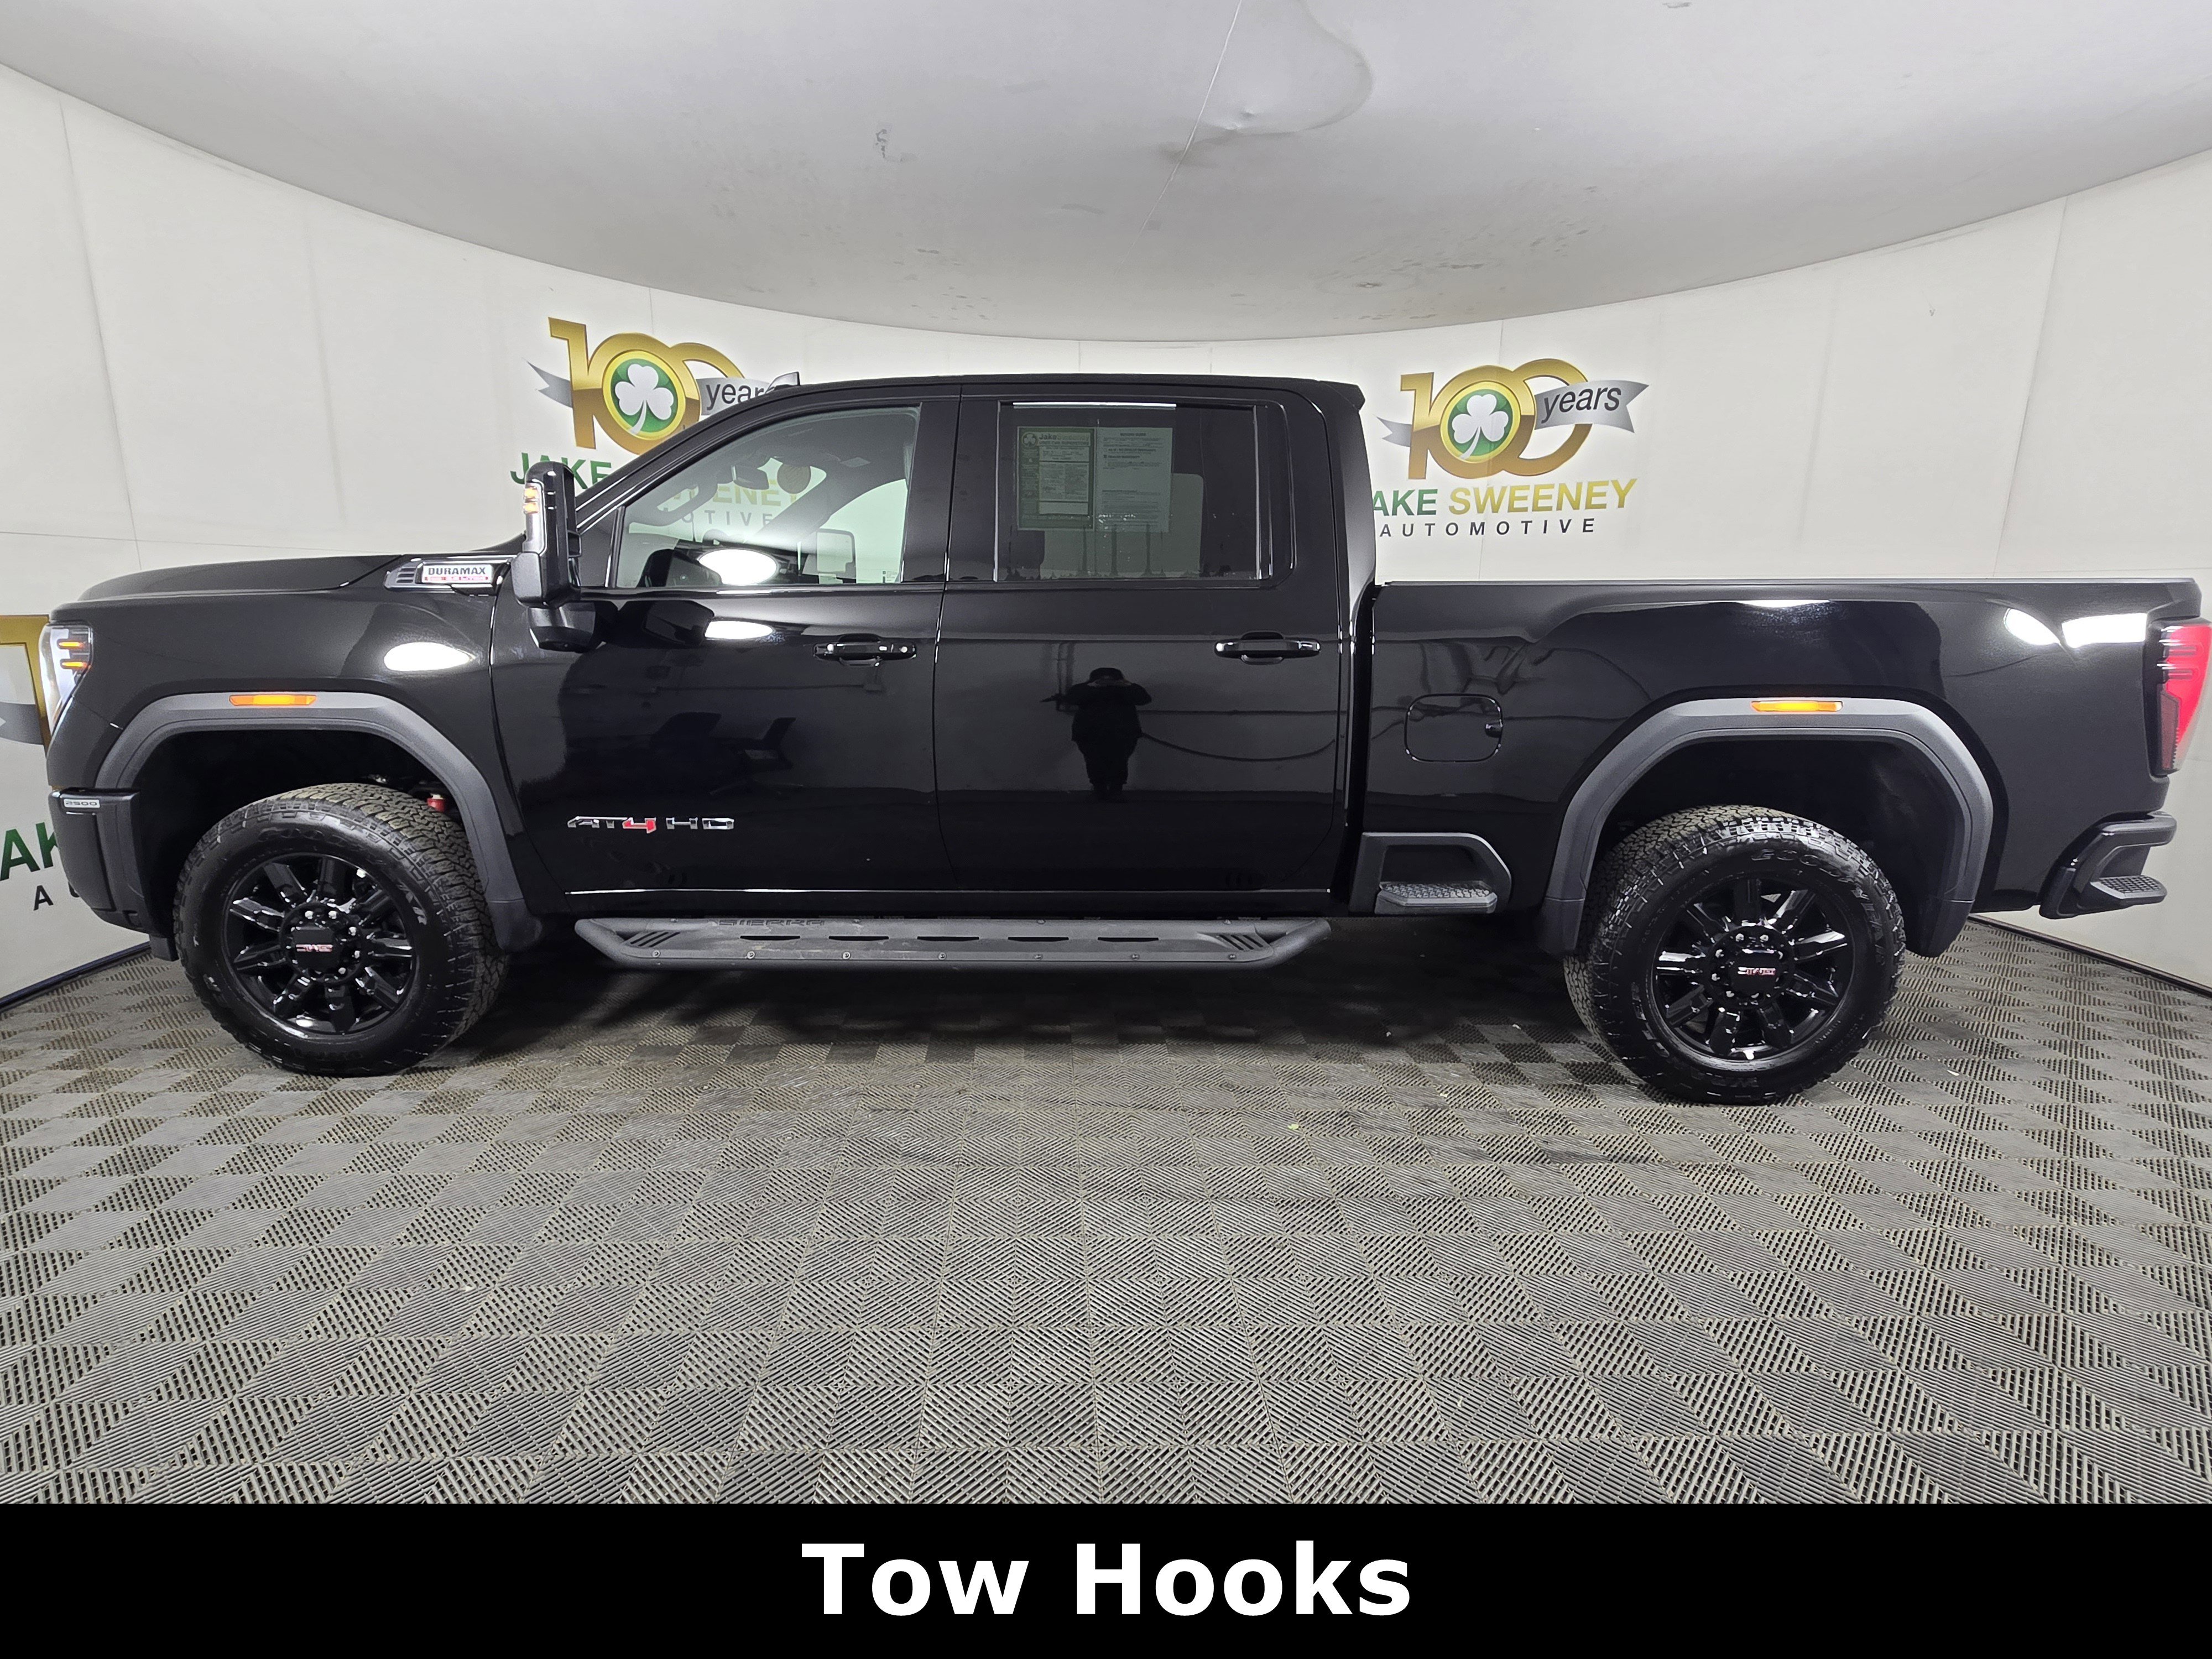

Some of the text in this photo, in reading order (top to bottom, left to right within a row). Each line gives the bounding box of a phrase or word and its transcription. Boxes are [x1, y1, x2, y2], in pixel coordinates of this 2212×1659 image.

[706, 383, 765, 411] year
[1541, 385, 1622, 424] years
[1400, 358, 1593, 479] 100
[510, 452, 612, 489] JKE
[1373, 478, 1637, 517] AKE SWEENEY
[1380, 518, 1595, 538] AUTOMOTIVE
[428, 567, 486, 576] DURAMAX
[567, 816, 734, 833] AT4 HD
